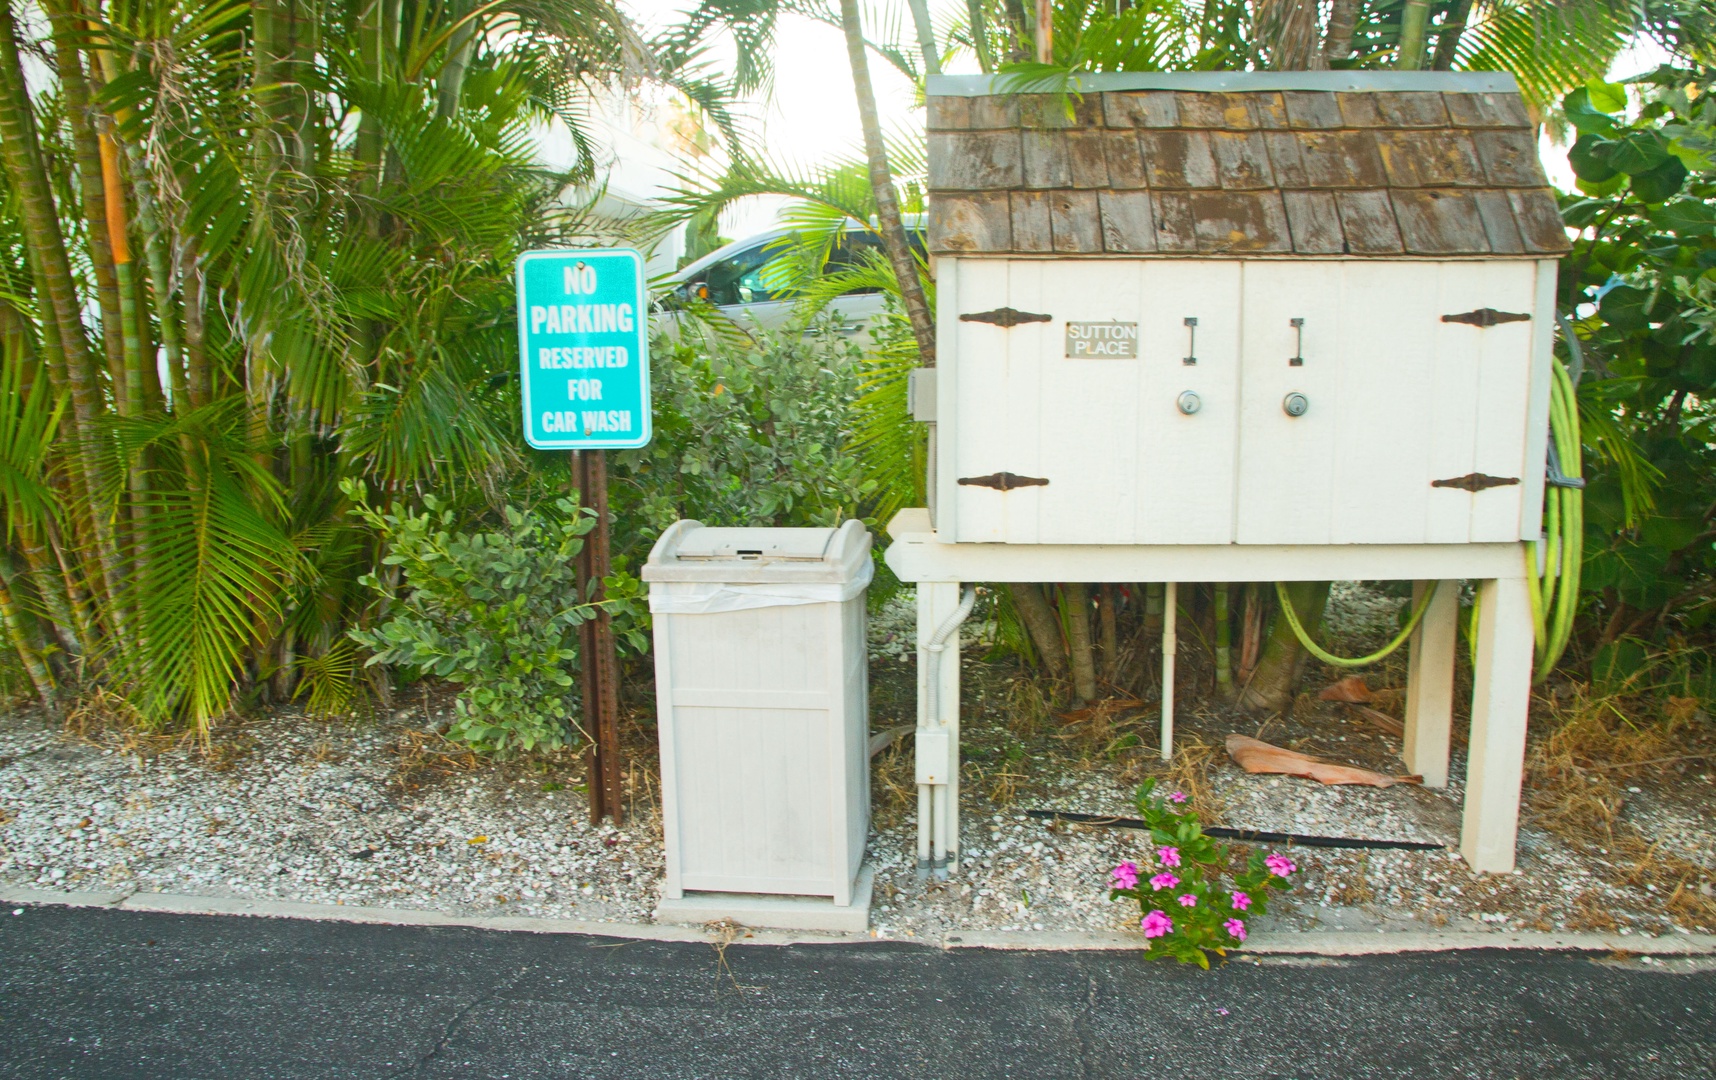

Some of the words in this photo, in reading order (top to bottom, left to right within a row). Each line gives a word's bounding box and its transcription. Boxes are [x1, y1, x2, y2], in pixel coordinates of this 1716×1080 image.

[563, 265, 597, 295] NO
[530, 303, 634, 334] PARKING
[1068, 325, 1136, 339] SUTTON
[538, 346, 629, 370] RESERVED
[1074, 341, 1130, 355] PLACE
[567, 379, 603, 401] FOR
[541, 411, 578, 433] CAR
[581, 410, 632, 432] WASH
